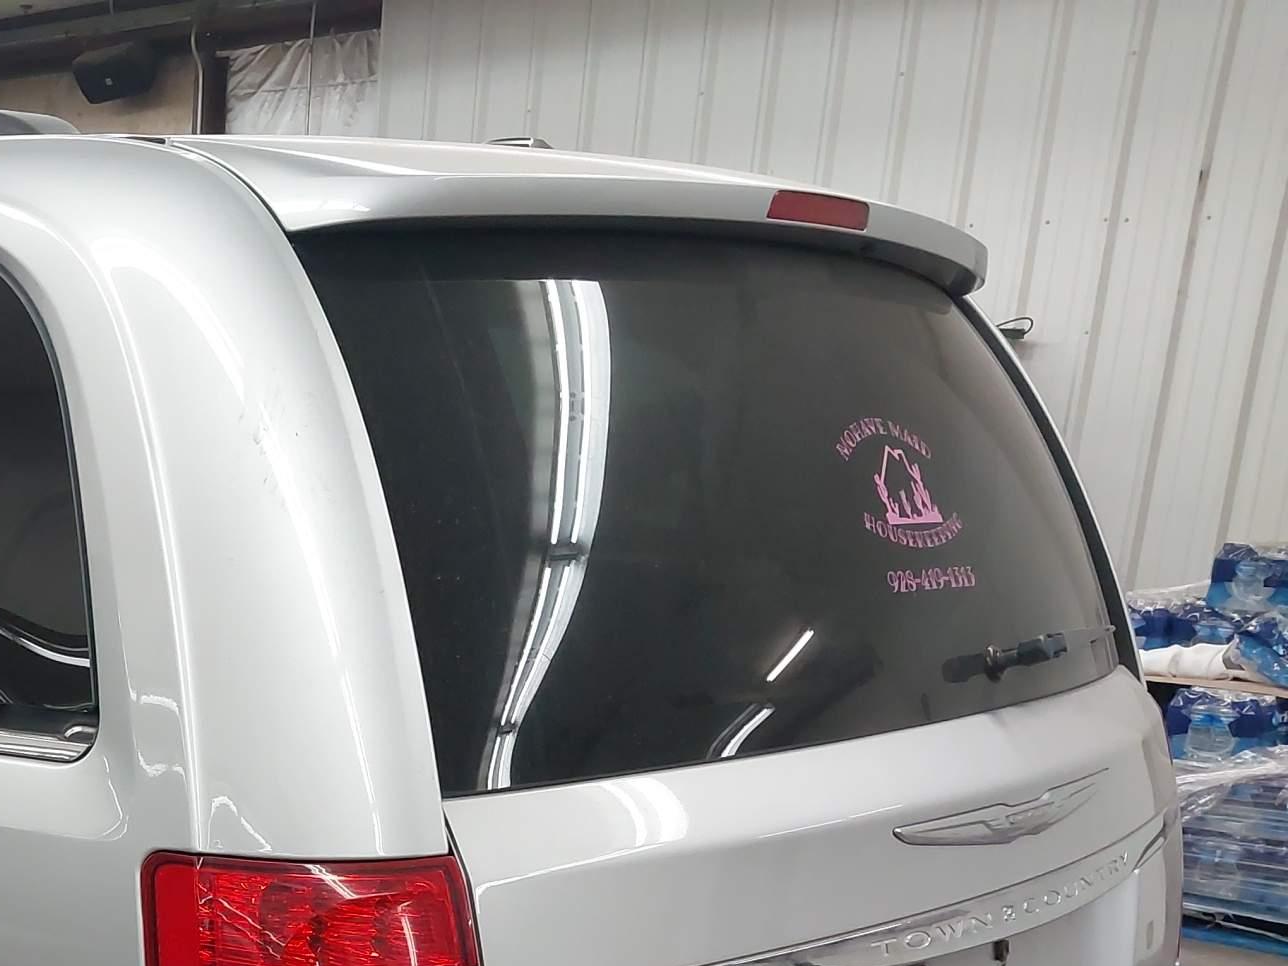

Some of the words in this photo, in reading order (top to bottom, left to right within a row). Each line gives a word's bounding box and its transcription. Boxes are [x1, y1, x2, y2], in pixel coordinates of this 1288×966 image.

[836, 417, 888, 461] MOHAVE
[863, 511, 963, 548] HOUSEKEEPING
[871, 911, 993, 957] TOWN
[1023, 850, 1129, 914] COUNTRY
